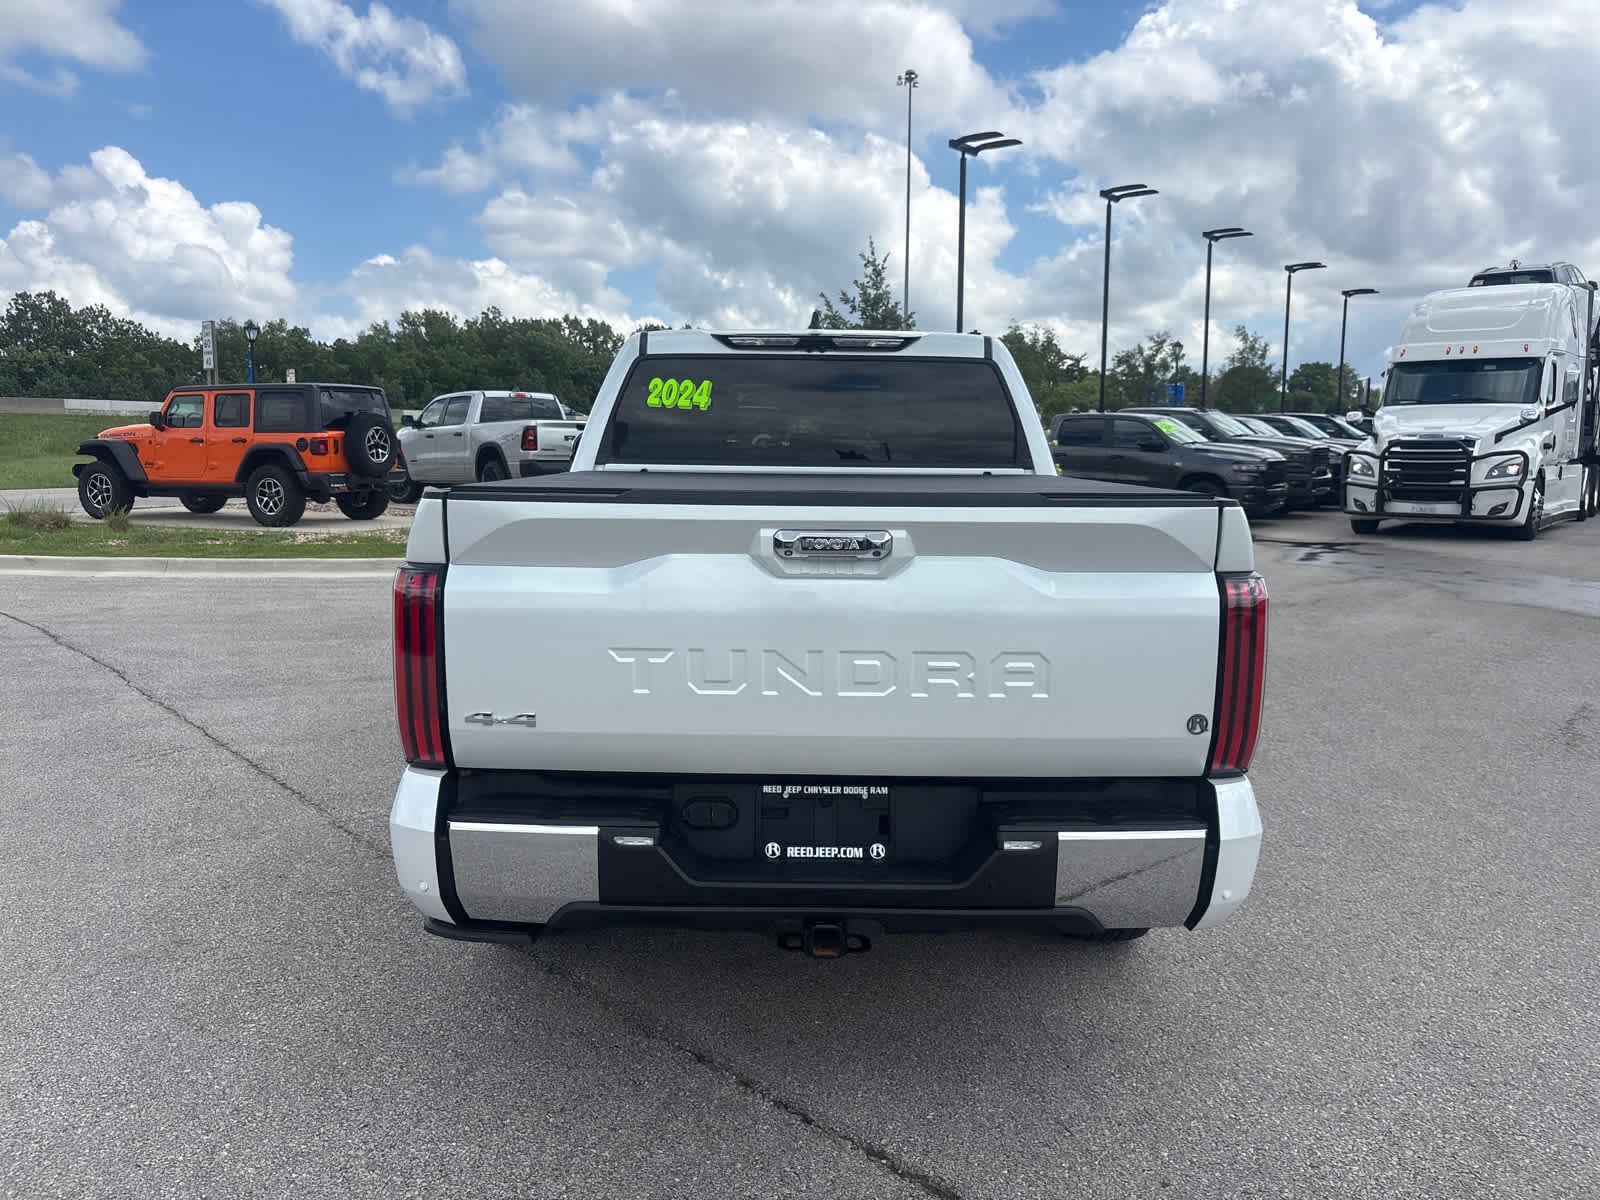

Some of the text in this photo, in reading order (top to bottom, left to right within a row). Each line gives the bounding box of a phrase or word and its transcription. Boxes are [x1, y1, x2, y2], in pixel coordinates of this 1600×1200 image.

[647, 377, 712, 411] 2024
[806, 537, 860, 550] TOYOTA
[607, 647, 1051, 698] TUNDRA
[763, 785, 888, 795] REED JEEP CHRYSLER DODGE RAM
[787, 847, 863, 858] REEDJEEP.COM
